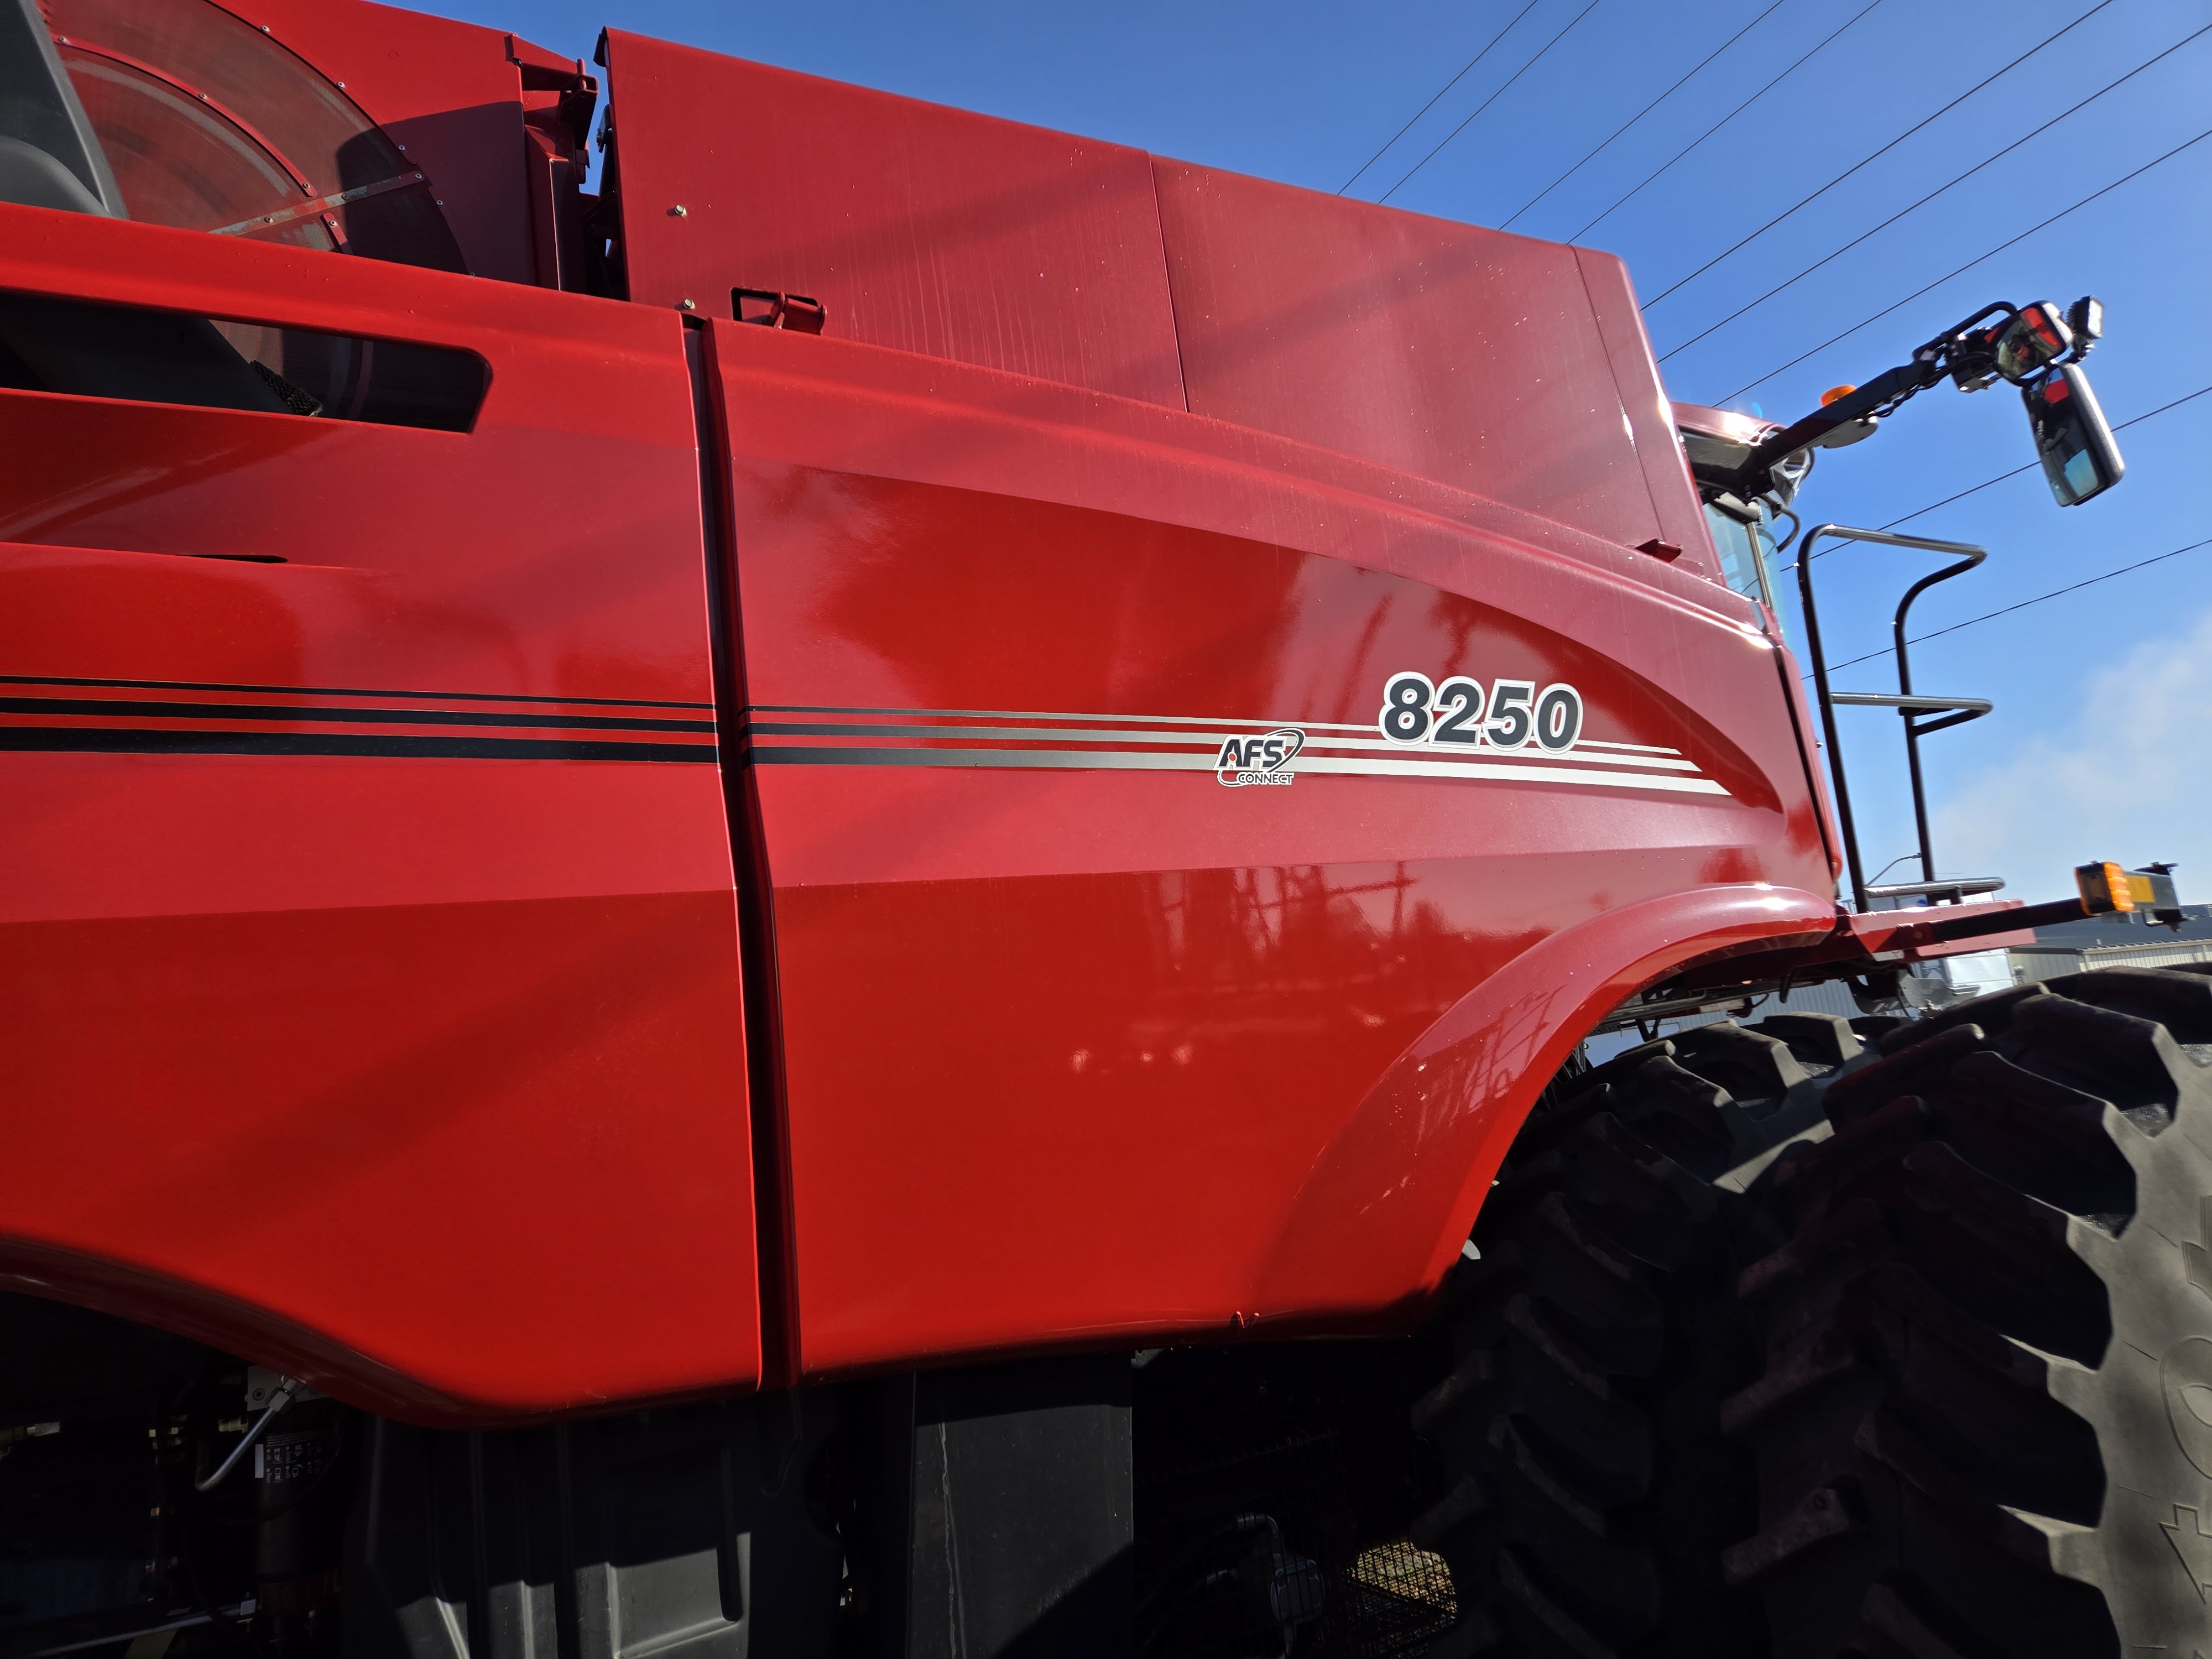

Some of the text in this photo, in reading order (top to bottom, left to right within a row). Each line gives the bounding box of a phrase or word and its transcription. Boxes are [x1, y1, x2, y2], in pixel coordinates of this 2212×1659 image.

[1381, 674, 1580, 752] 8250
[1217, 738, 1285, 769] AFS
[1238, 773, 1293, 784] CONNECT
